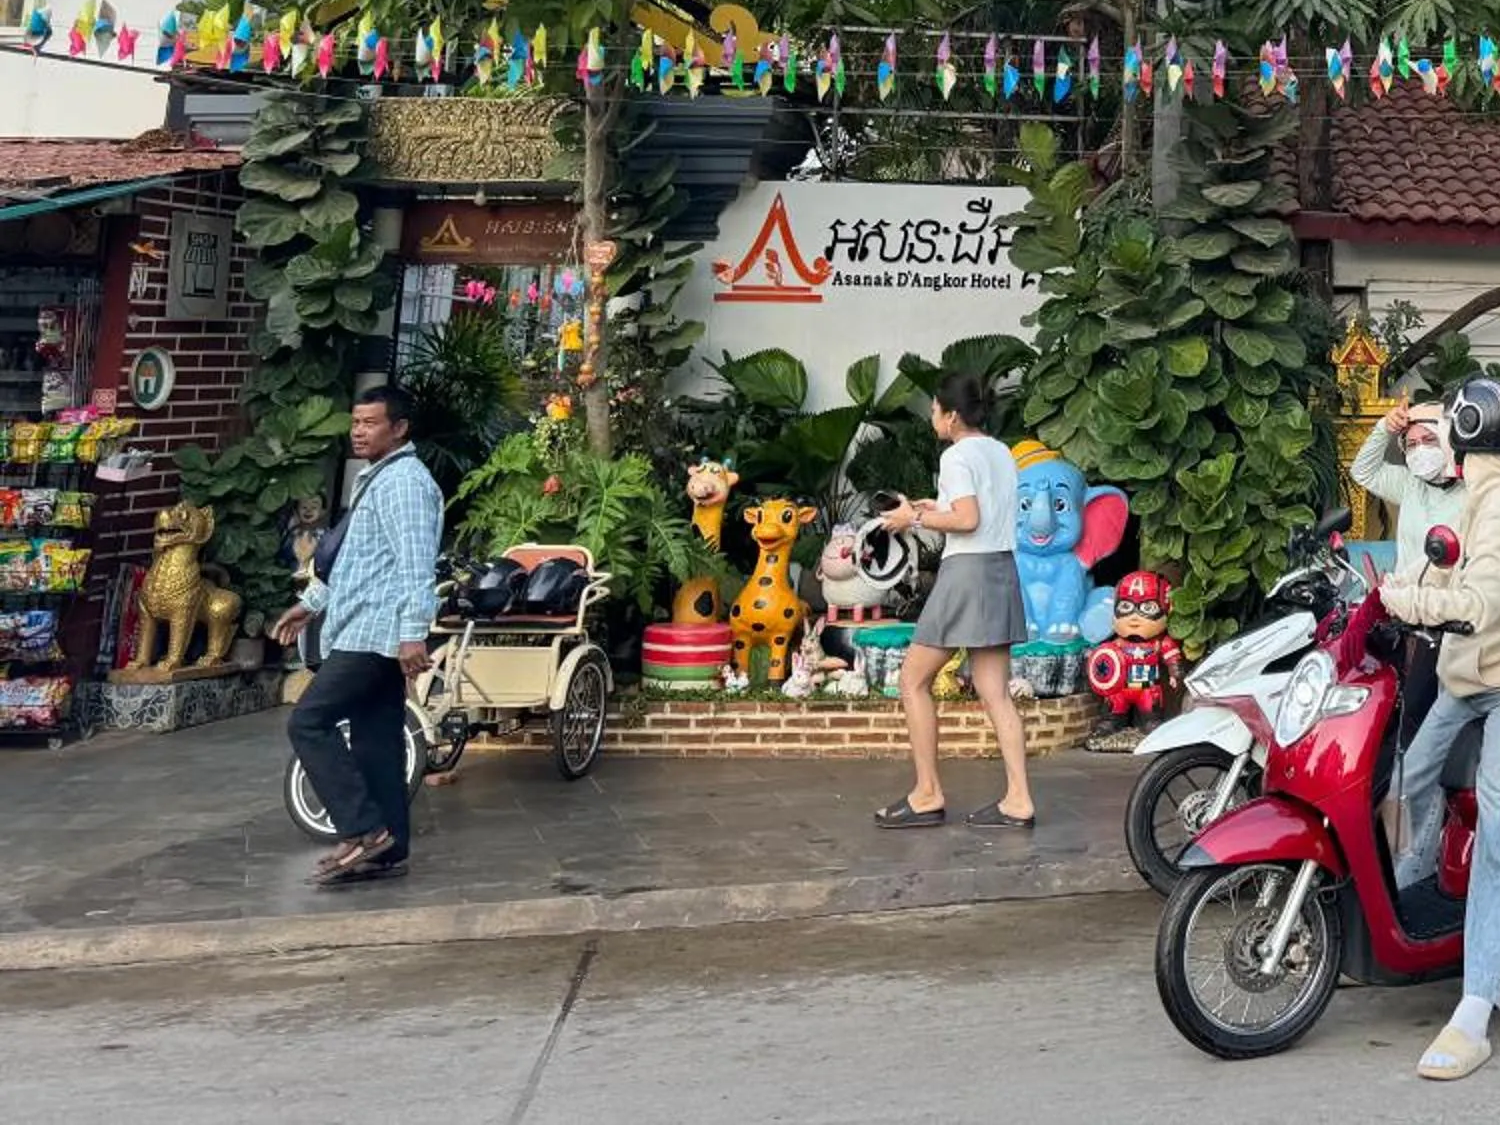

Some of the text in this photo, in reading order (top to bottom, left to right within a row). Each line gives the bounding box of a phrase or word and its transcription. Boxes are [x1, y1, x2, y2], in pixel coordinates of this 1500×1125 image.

[832, 271, 893, 287] Asanak
[971, 273, 1011, 289] Hotel
[1129, 577, 1145, 596] A
